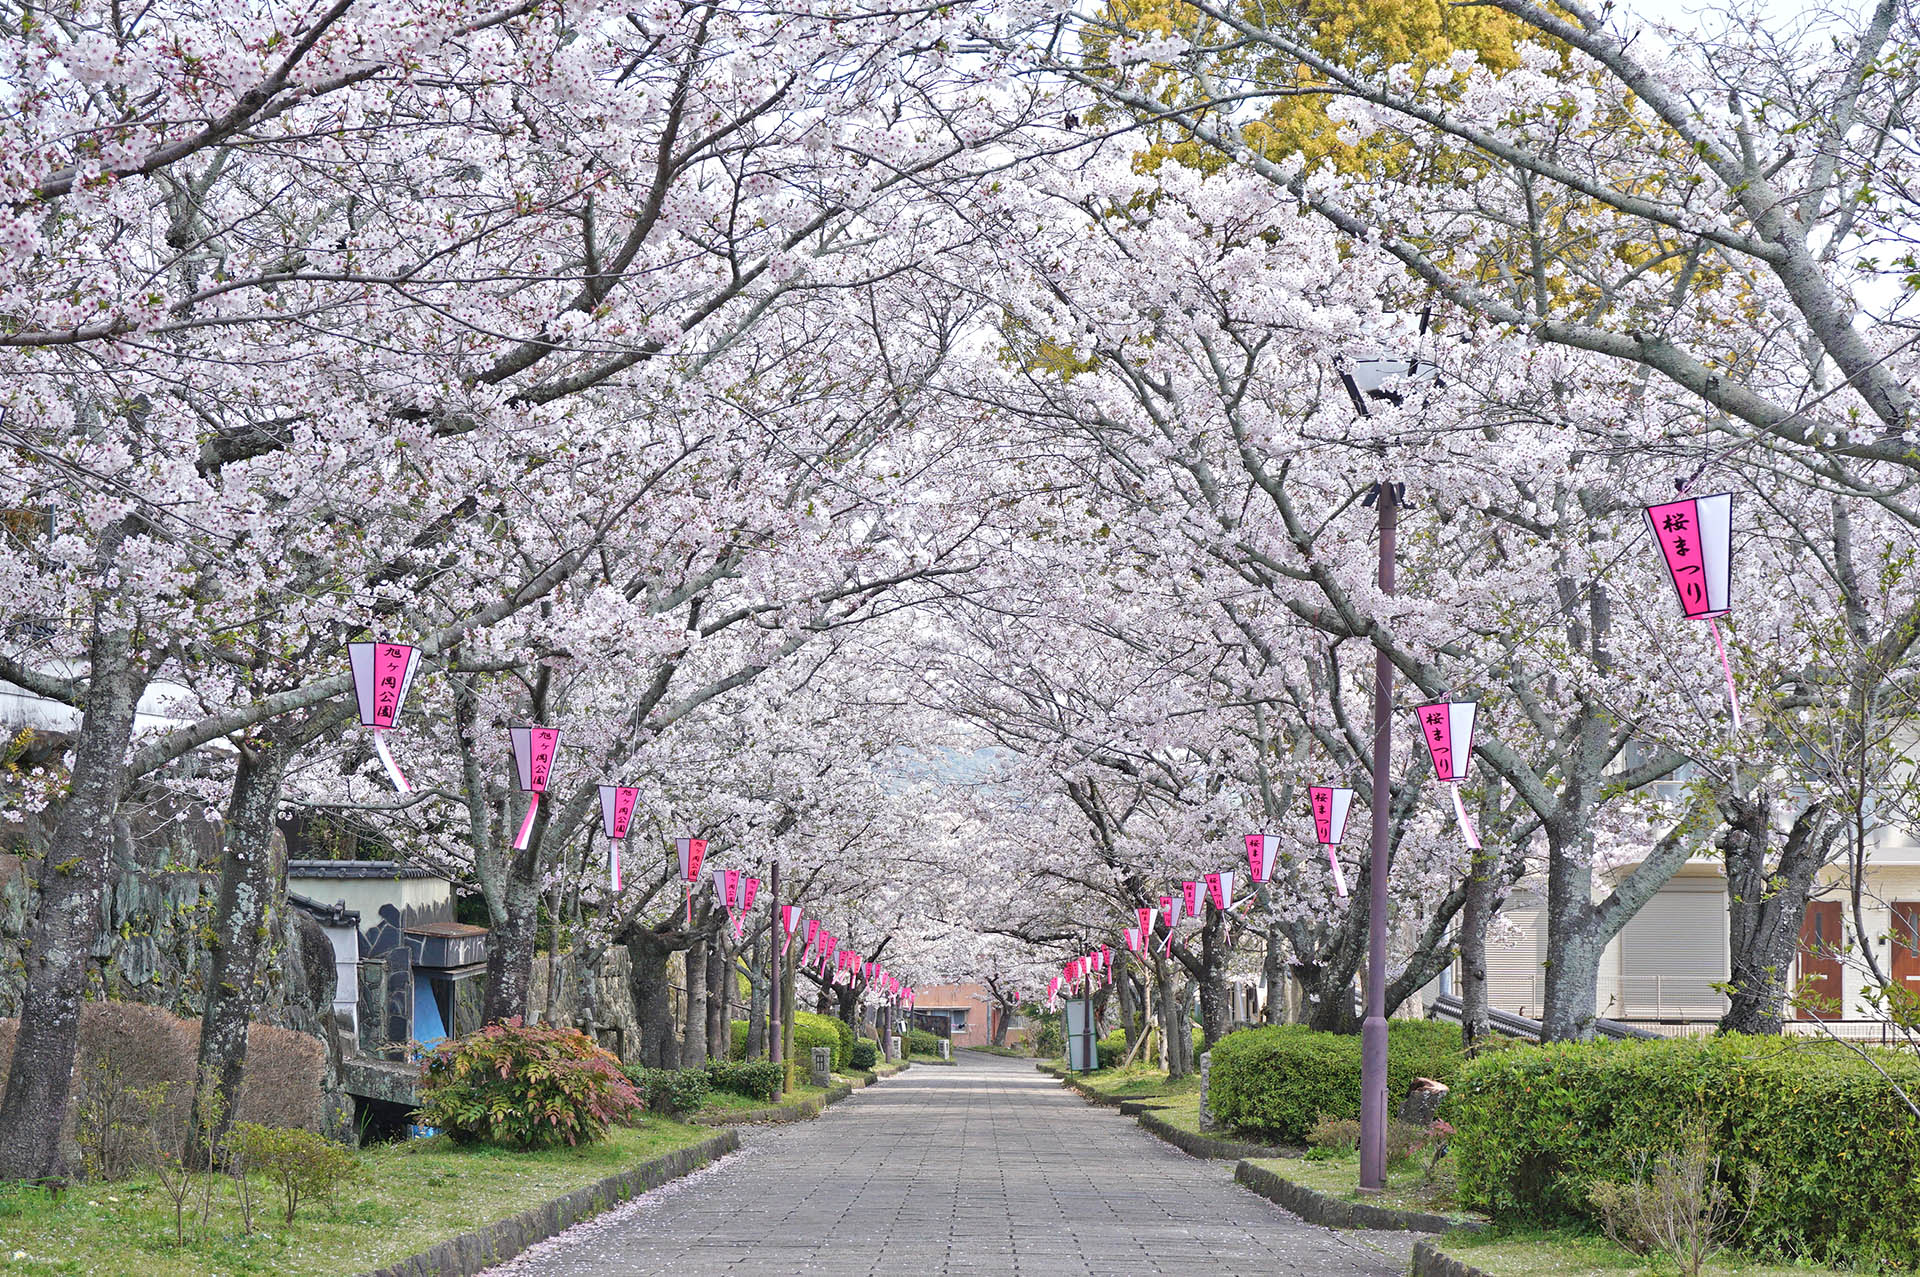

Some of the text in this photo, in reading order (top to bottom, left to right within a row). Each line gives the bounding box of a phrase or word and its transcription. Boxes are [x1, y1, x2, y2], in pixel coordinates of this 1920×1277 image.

[1662, 513, 1701, 604] 桜まつり
[1426, 712, 1449, 773] 桜まつり
[1315, 792, 1329, 838] 桜まつり
[1249, 839, 1261, 877] 桜まつり
